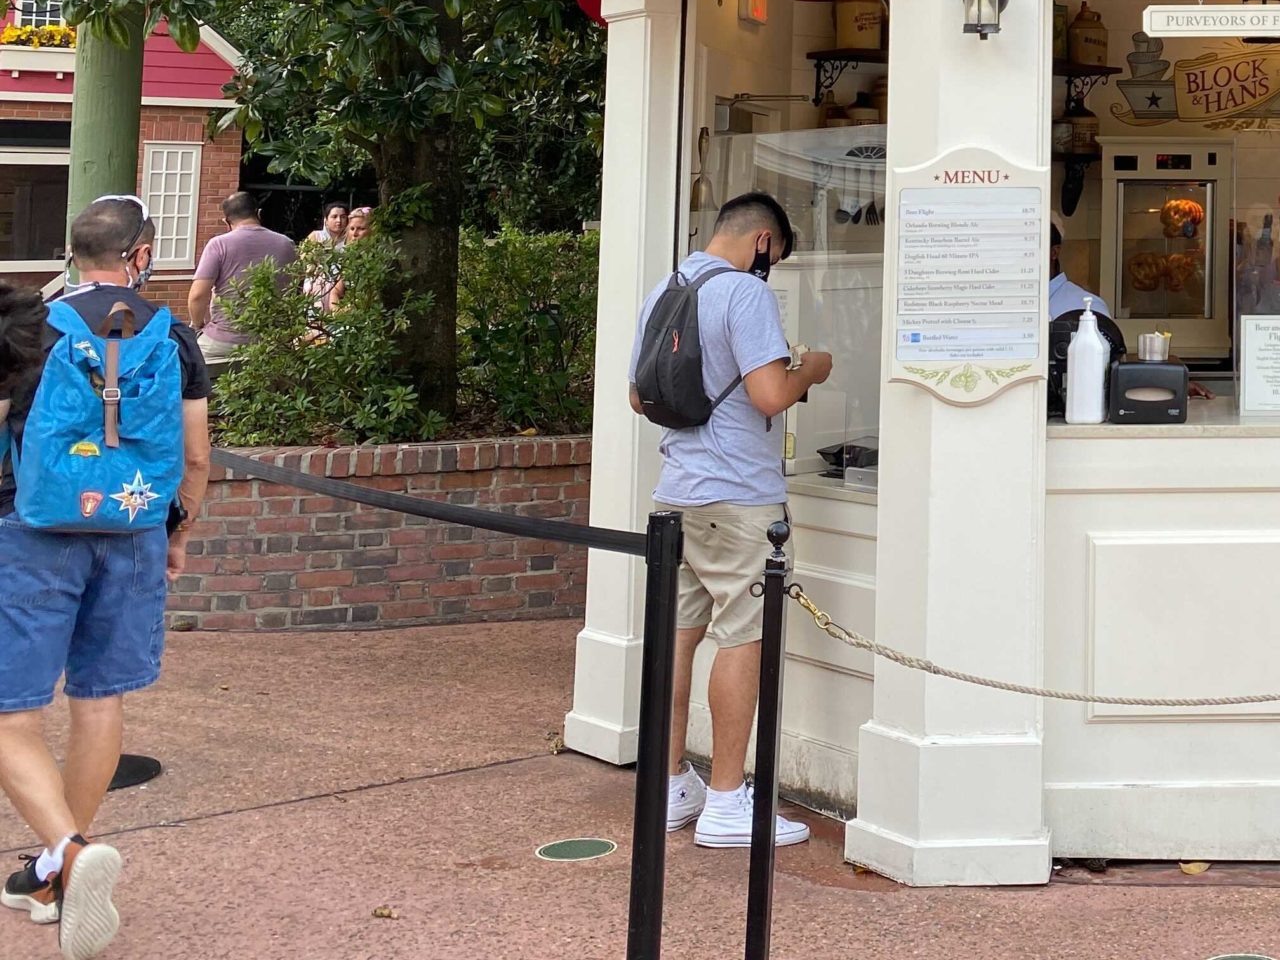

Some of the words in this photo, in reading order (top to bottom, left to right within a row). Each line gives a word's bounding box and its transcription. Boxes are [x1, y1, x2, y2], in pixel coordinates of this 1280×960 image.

[1166, 15, 1246, 27] PURVEYORS
[1250, 15, 1268, 26] OF
[1185, 58, 1269, 94] BLOCK
[1192, 96, 1203, 106] &
[1203, 77, 1270, 114] HANS
[943, 170, 1001, 185] MENU
